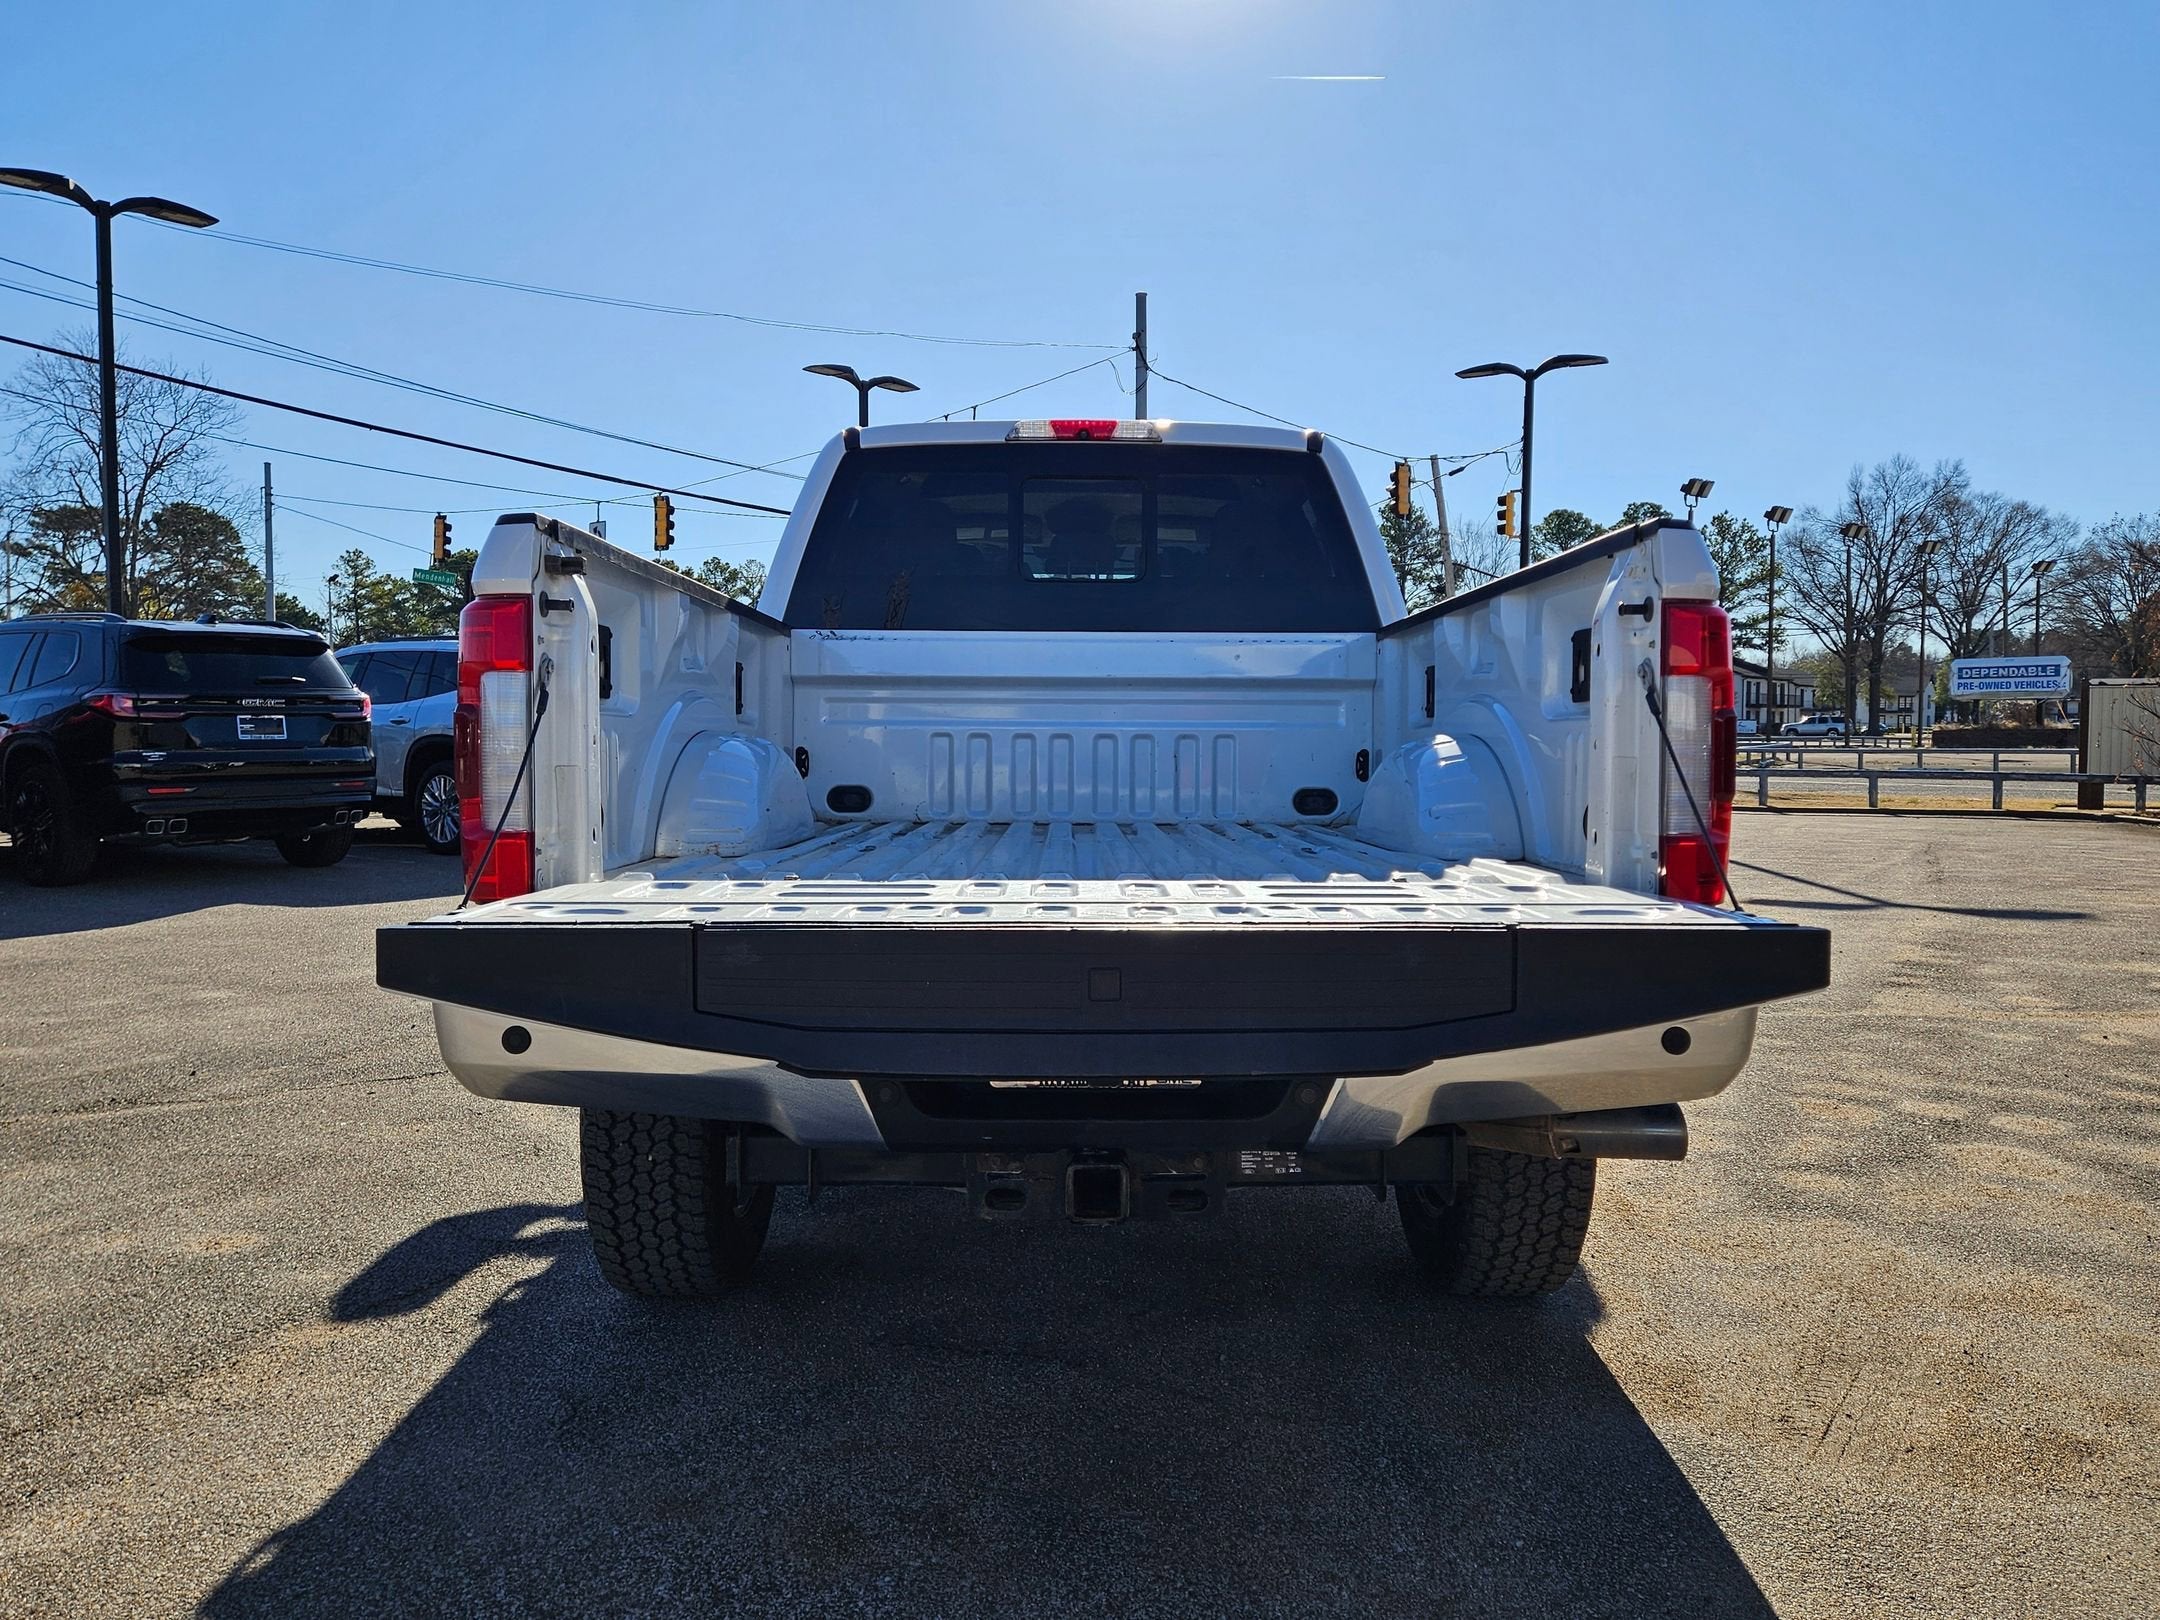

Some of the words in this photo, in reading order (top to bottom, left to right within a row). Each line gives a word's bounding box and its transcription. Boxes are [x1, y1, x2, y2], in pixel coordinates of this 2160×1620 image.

[414, 571, 455, 584] Mendenhall
[1962, 666, 2056, 678] DEPENDABLE
[1957, 681, 2012, 691] PRE-OWNED
[2014, 680, 2060, 690] VEHICLES
[242, 698, 286, 707] GMC
